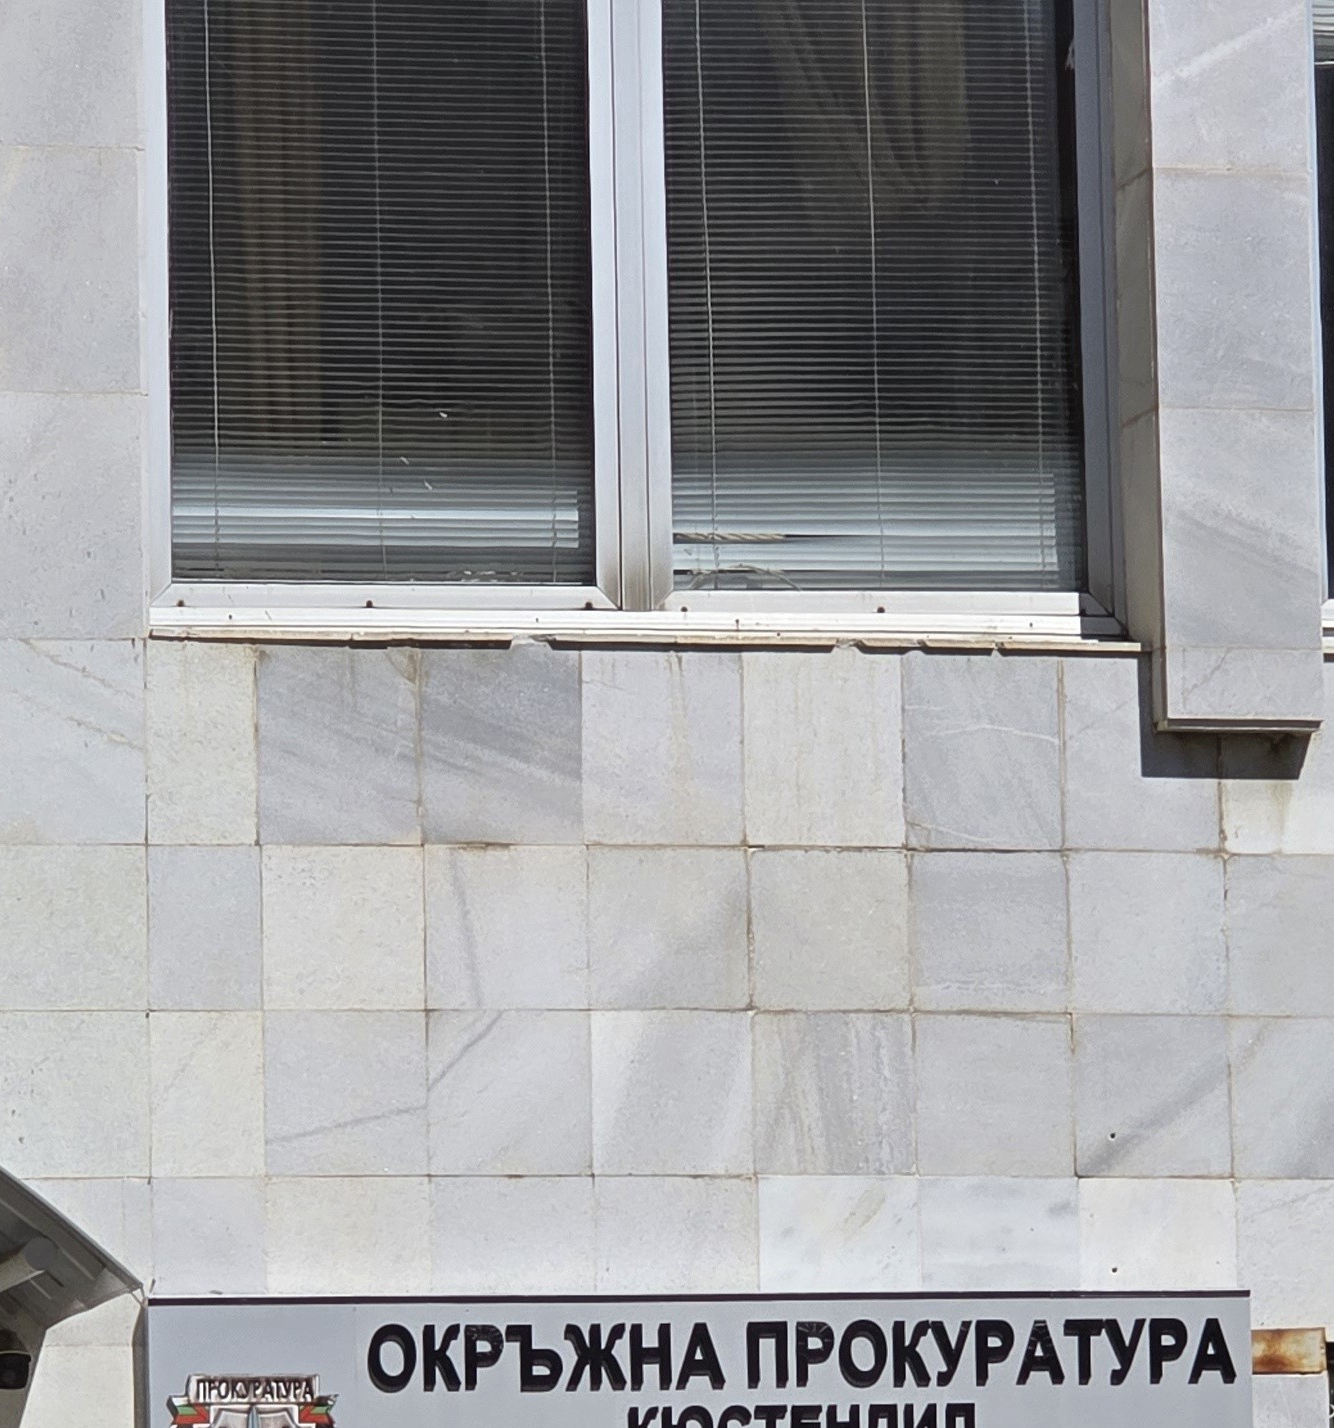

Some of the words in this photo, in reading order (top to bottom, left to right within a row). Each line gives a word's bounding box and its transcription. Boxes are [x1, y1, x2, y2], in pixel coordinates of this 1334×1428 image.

[367, 1321, 726, 1393] ОКРЪЖНА
[746, 1318, 1237, 1389] ПРОКУРАТУРА
[196, 1378, 315, 1400] ПРОКУРАТУРА
